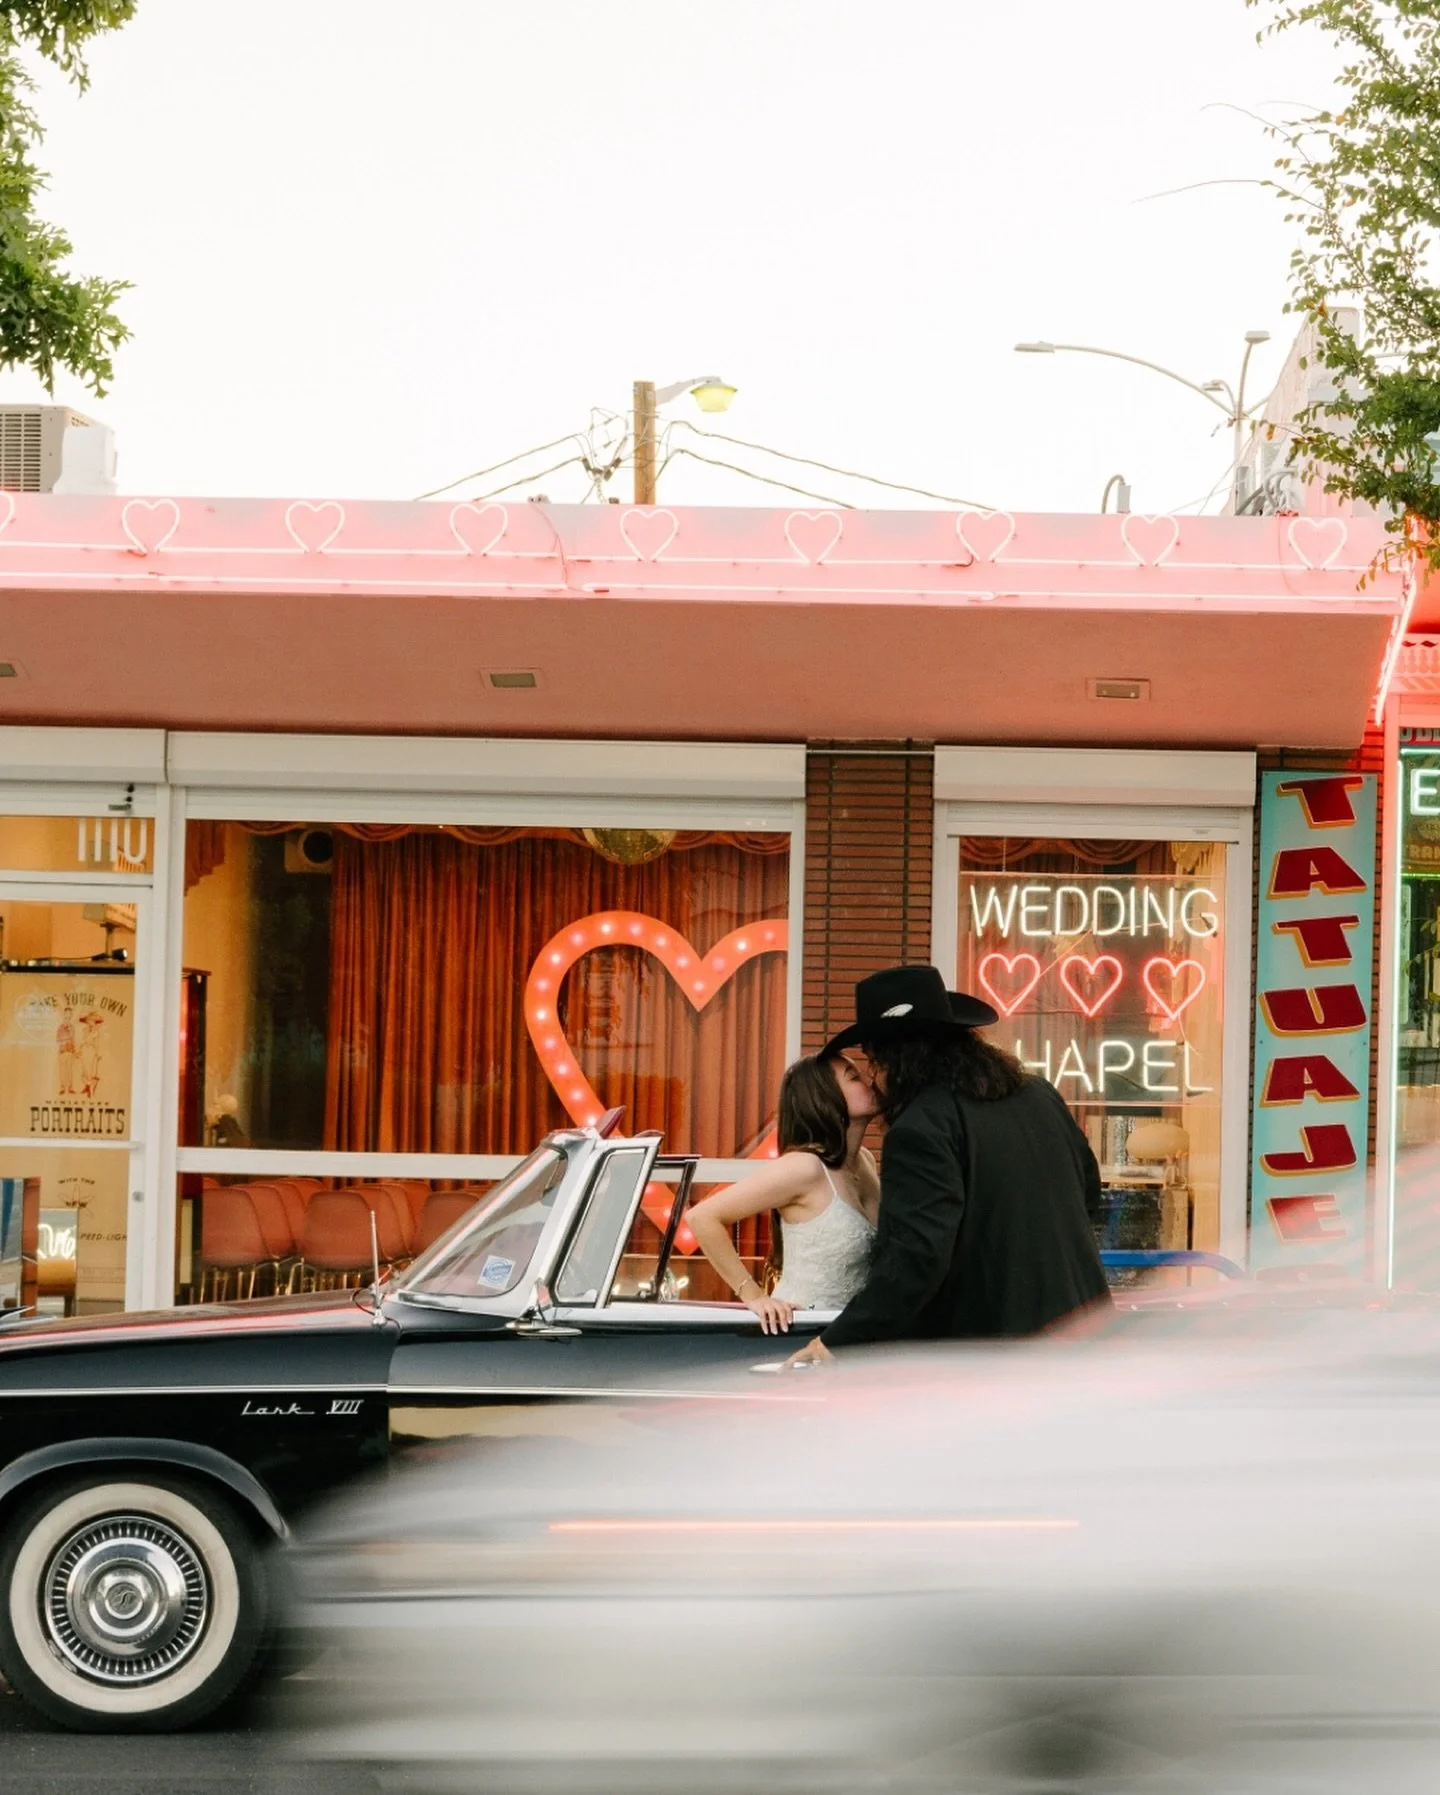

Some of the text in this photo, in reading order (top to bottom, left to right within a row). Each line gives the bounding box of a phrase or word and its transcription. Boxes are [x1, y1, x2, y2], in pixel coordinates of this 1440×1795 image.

[970, 884, 1219, 938] WEDDING
[64, 992, 95, 1006] YOUR
[100, 996, 127, 1017] OWN
[1016, 1039, 1214, 1093] HAPEL
[30, 1106, 125, 1134] PORTRAITS
[241, 1399, 364, 1415] Lark VIII
